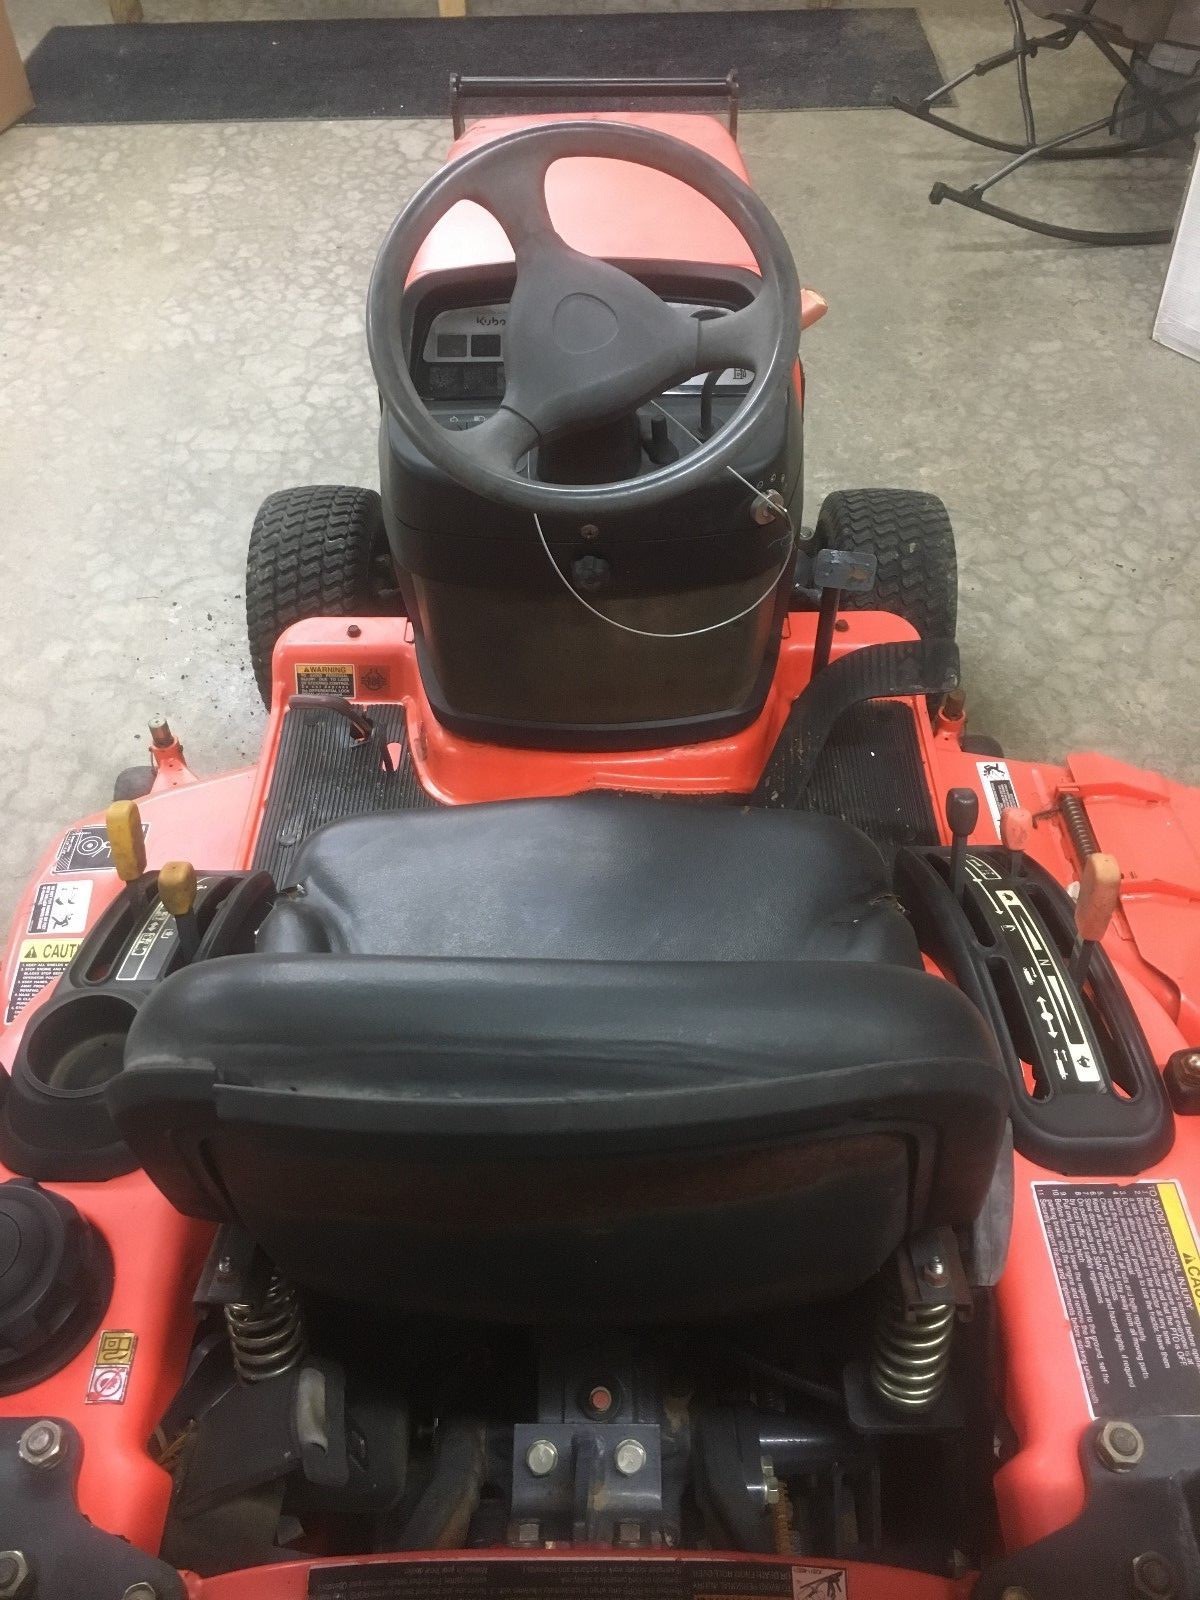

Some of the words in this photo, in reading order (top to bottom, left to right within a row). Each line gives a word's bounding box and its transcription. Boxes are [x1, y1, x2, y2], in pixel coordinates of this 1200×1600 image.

[43, 943, 80, 959] CAUT
[1146, 1185, 1157, 1196] TO
[1150, 1198, 1166, 1224] AVOID
[1159, 1226, 1183, 1274] PERSONAL
[1187, 1266, 1200, 1305] CAU
